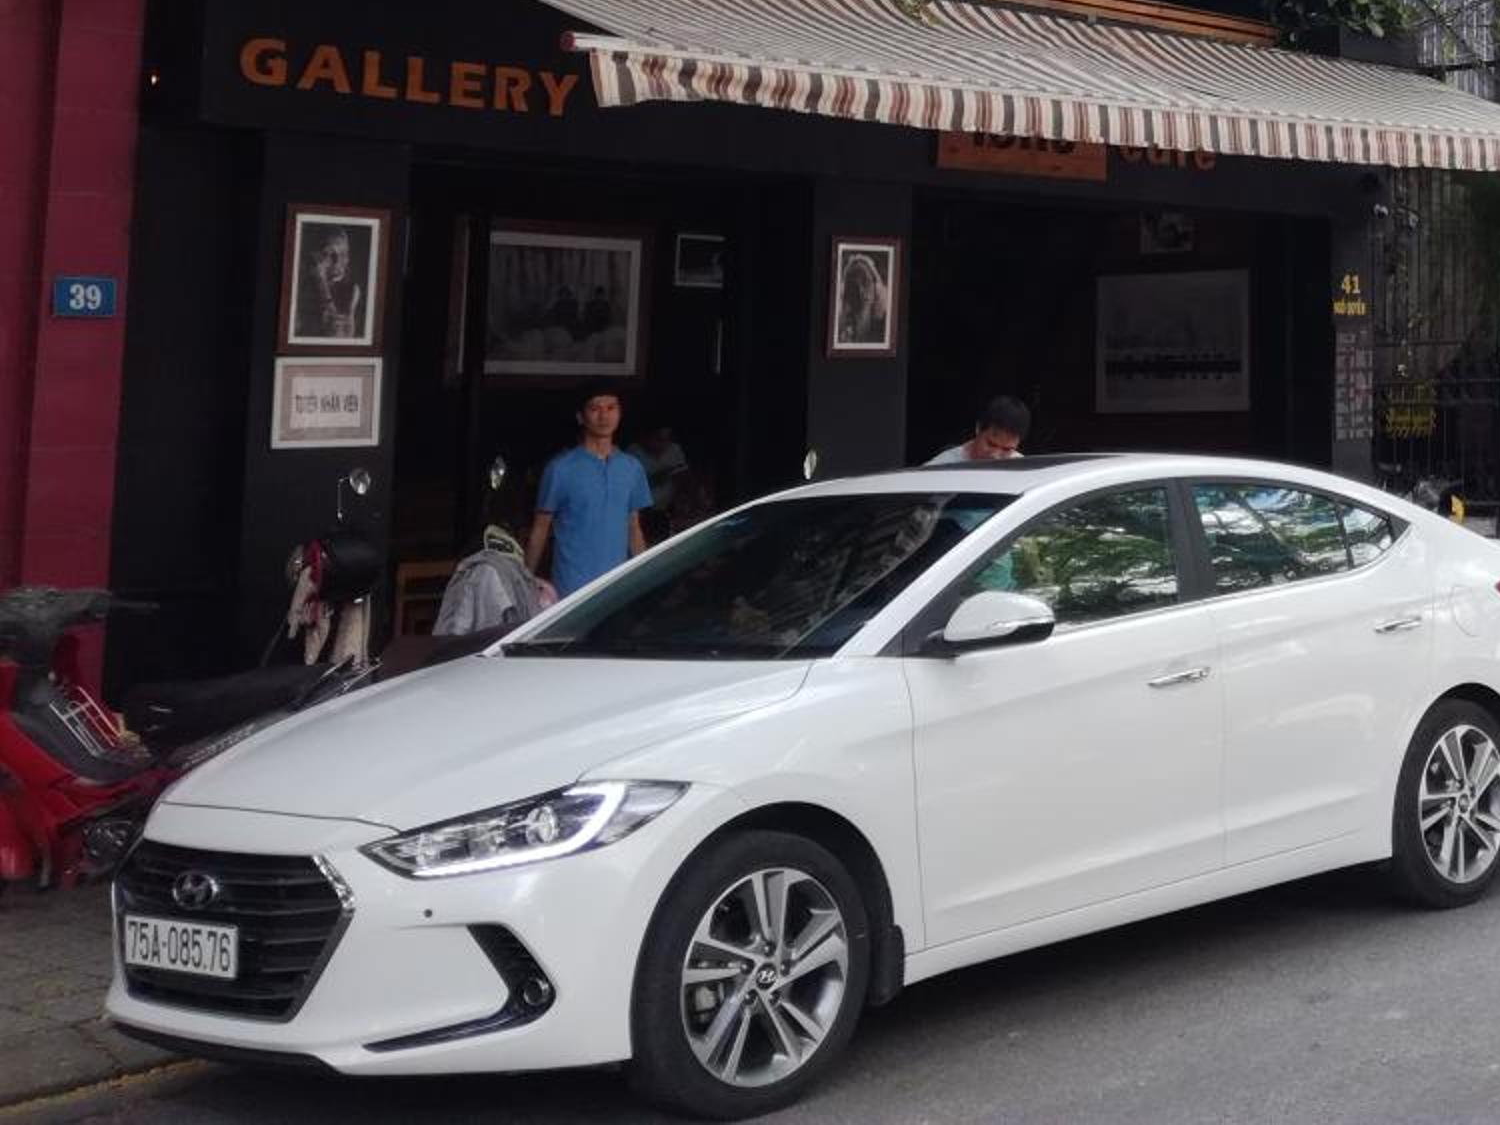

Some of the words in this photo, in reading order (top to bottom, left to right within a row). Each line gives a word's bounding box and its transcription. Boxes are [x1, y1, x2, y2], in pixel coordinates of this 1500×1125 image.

[239, 38, 578, 117] GALLERY
[69, 283, 102, 310] 39
[1341, 274, 1361, 294] 41
